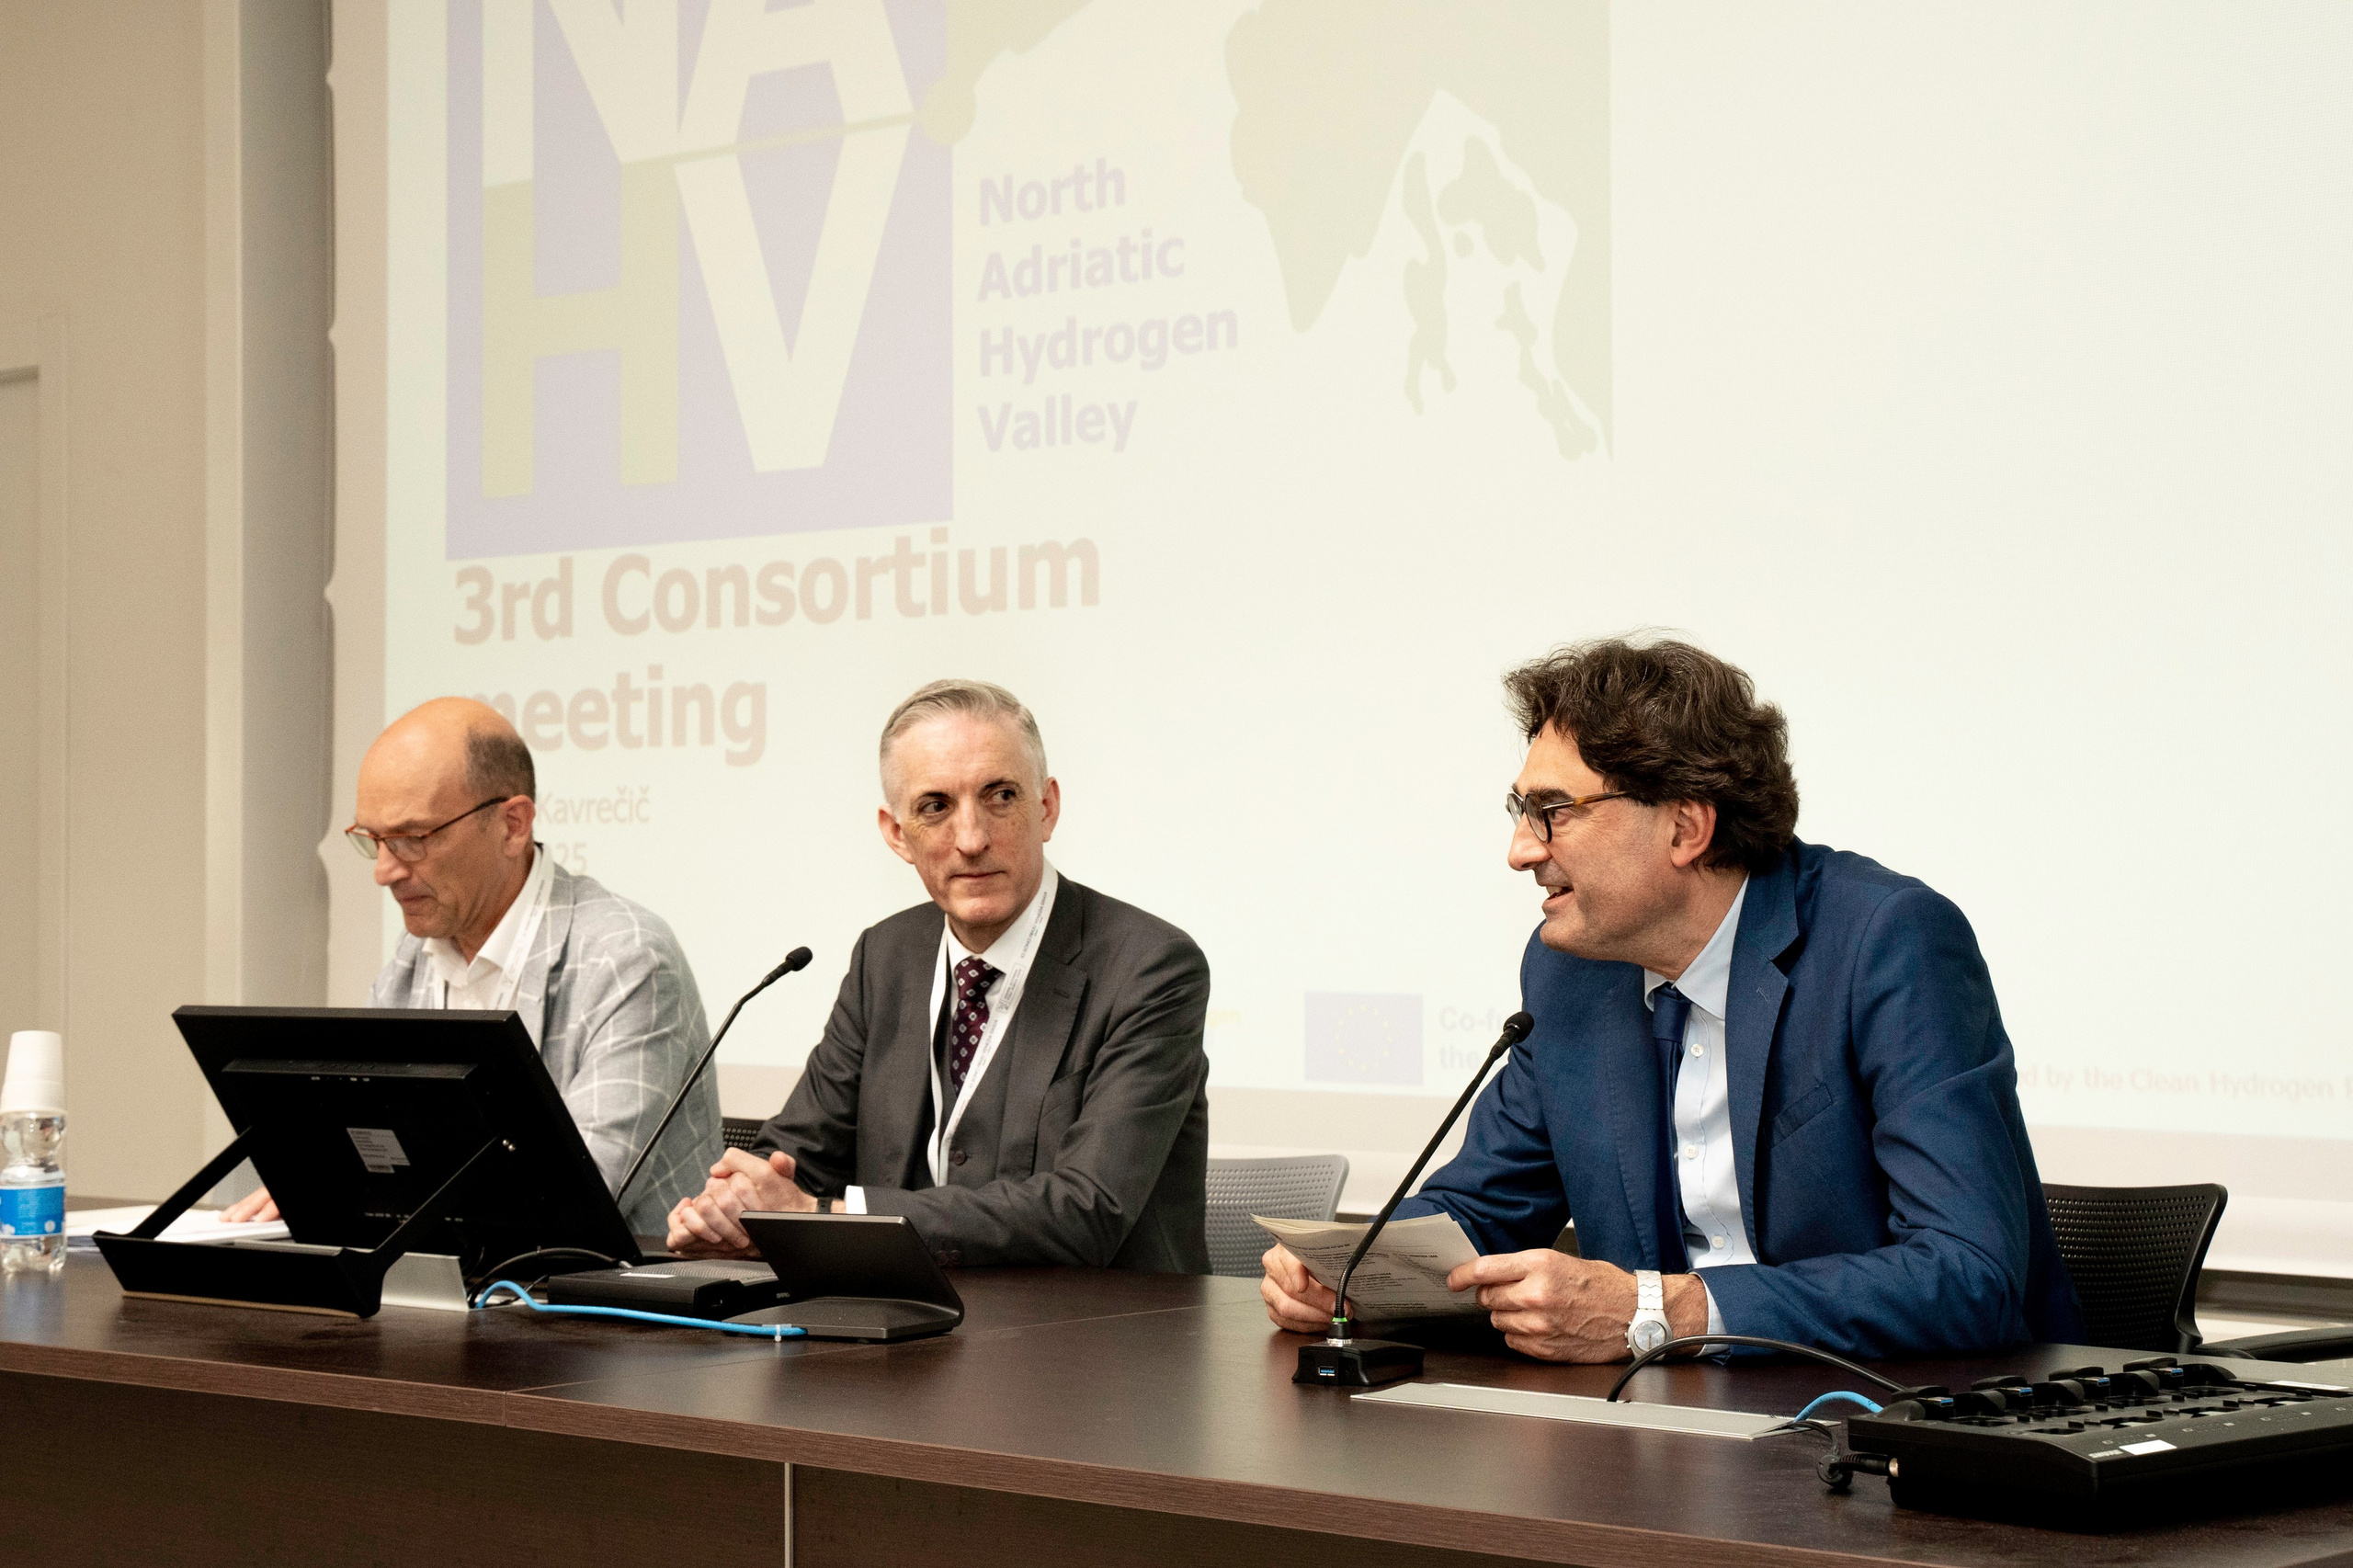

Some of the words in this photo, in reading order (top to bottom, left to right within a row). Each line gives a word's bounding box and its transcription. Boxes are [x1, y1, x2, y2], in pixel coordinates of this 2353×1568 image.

[978, 157, 1126, 226] North
[977, 228, 1187, 302] Adriatic
[979, 307, 1239, 383] Hydrogen
[976, 394, 1139, 453] Valley
[454, 556, 574, 644] 3rd
[601, 526, 1101, 636] Consortium
[535, 785, 651, 824] Kavrečič
[1439, 1045, 1481, 1070] the
[2045, 1064, 2074, 1095] by
[2084, 1065, 2123, 1090] the
[2128, 1067, 2200, 1094] Clean
[2210, 1071, 2334, 1102] Hydrogen
